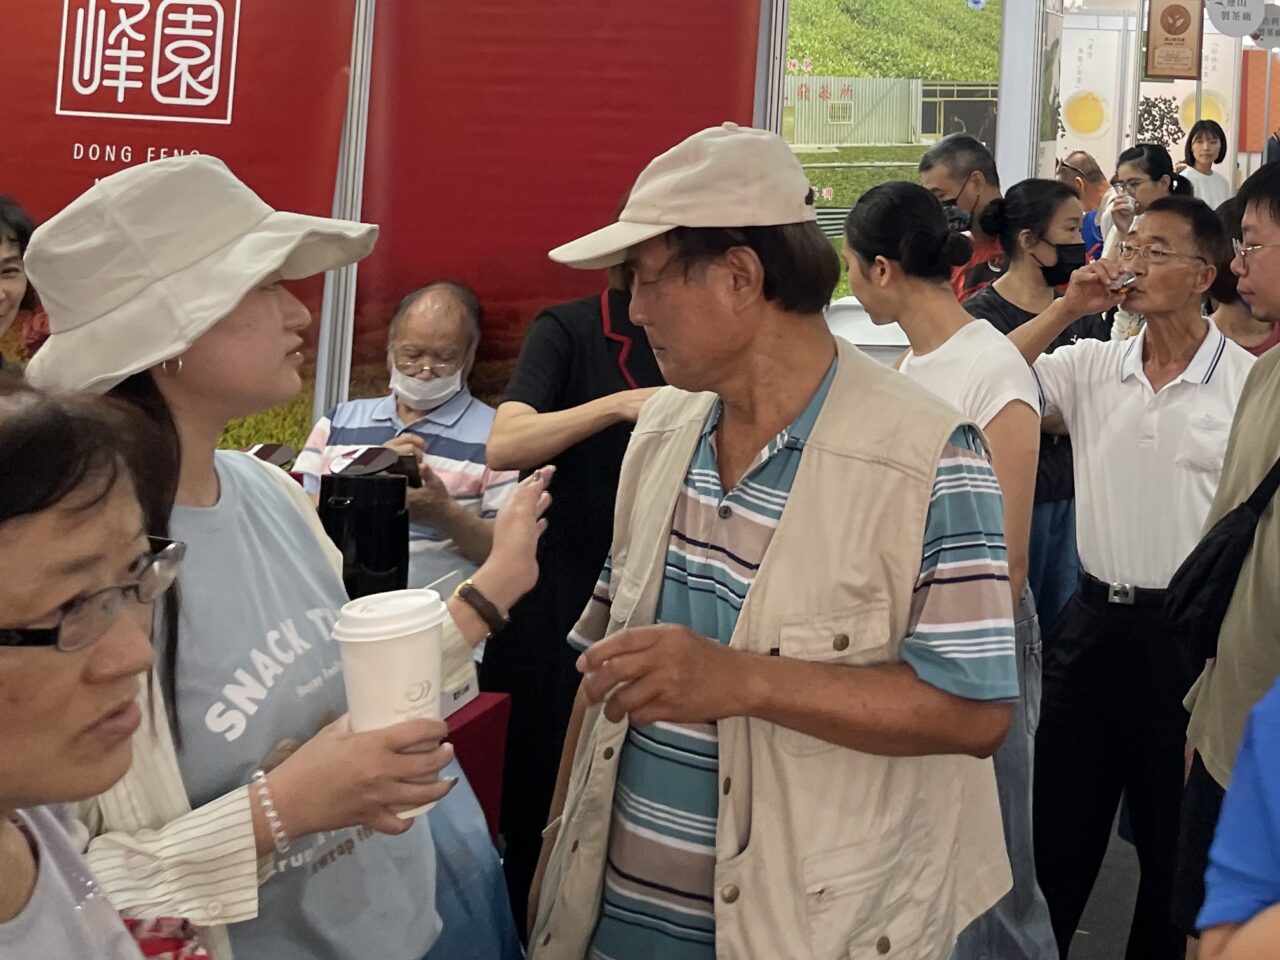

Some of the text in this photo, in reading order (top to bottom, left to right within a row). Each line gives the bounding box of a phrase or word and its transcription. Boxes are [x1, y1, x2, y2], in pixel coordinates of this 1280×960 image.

[1221, 10, 1252, 21] 製茶廠
[74, 143, 132, 162] DONG
[205, 618, 312, 742] SNACK
